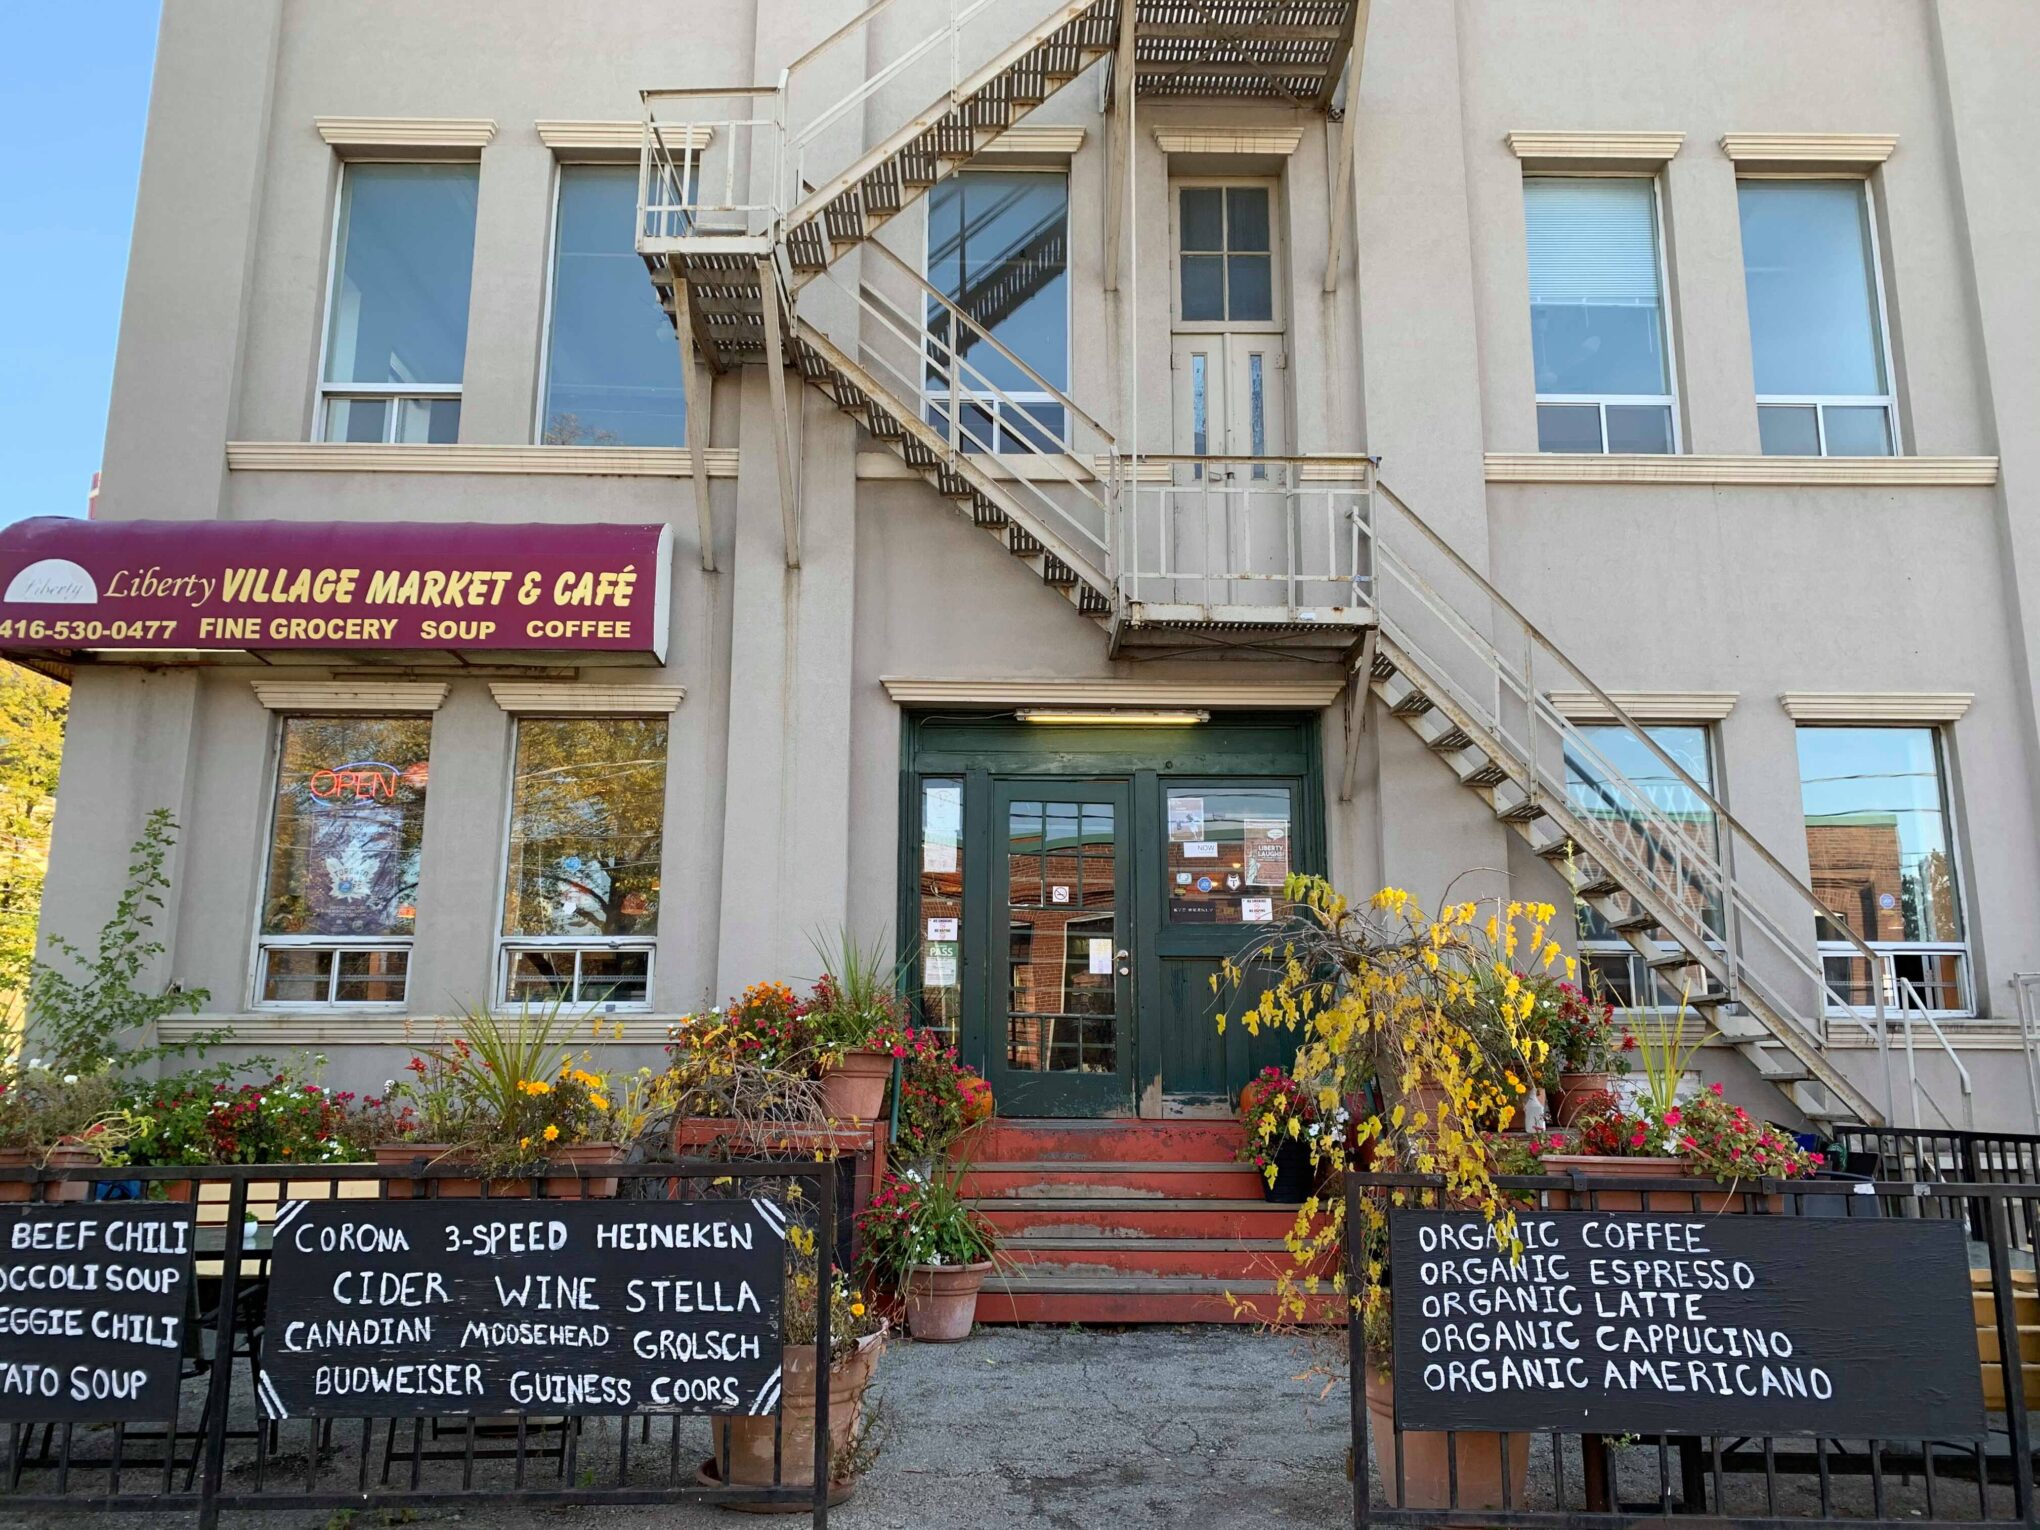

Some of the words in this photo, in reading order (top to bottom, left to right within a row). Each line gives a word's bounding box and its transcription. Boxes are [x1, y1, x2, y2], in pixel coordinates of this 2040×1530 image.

[104, 566, 216, 608] Liberty
[222, 568, 360, 603] VILLAGE
[365, 570, 513, 608] MARKET
[517, 570, 542, 606] &
[553, 564, 638, 607] CAFÉ
[0, 619, 177, 640] 416-530-0477
[199, 617, 262, 639] FINE
[269, 618, 399, 640] GROCERY
[420, 620, 496, 640] SOUP
[526, 620, 631, 638] COFFEE
[310, 770, 396, 798] OPEN
[929, 947, 954, 957] PASS
[11, 1220, 98, 1251] BEEF
[104, 1221, 189, 1255] CHILI
[295, 1222, 410, 1253] CORONA
[445, 1220, 568, 1256] 3-SPEED
[596, 1221, 753, 1251] HEINEKEN
[1582, 1221, 1711, 1253] COFFEE
[105, 1264, 180, 1294] SOUP
[1420, 1255, 1570, 1286] ORGANIC
[1589, 1259, 1755, 1291] ESPRESSO
[333, 1270, 451, 1307] CIDER
[494, 1274, 601, 1311] WINE
[625, 1279, 761, 1314] STELLA
[1422, 1284, 1583, 1318] ORGANIC
[1594, 1290, 1707, 1321] LATTE
[0, 1306, 84, 1336] EGGIE
[91, 1310, 179, 1349] CHILI
[284, 1316, 431, 1351] CANADIAN
[460, 1320, 610, 1348] MOOSEHEAD
[633, 1329, 760, 1363] GROLSCH
[1421, 1319, 1580, 1354] ORGANIC
[1595, 1323, 1793, 1358] CAPPUCINO
[70, 1365, 147, 1401] SOUP
[315, 1363, 484, 1396] BUDWEISER
[510, 1370, 632, 1406] GUINESS
[650, 1375, 740, 1405] COORS
[1423, 1355, 1589, 1393] ORGANIC
[1604, 1359, 1833, 1399] AMERICANO
